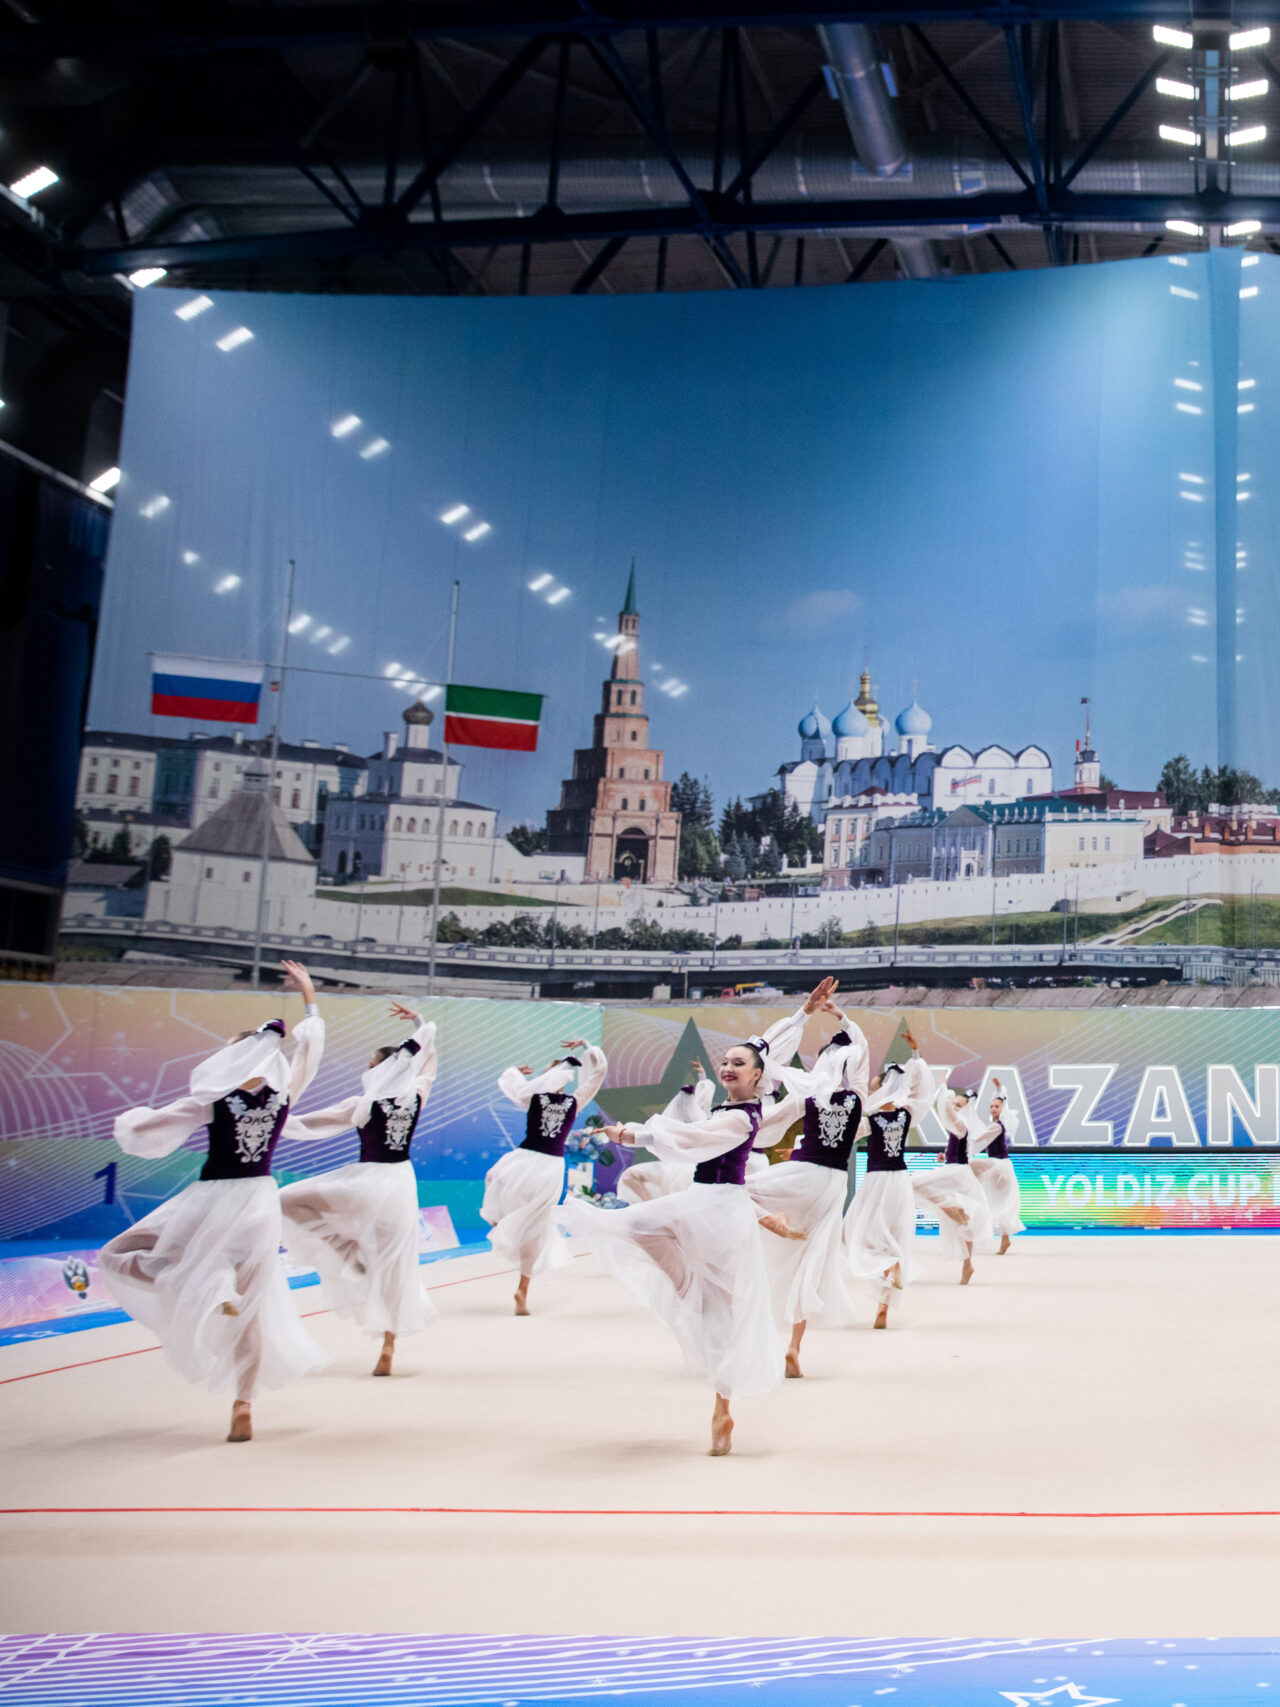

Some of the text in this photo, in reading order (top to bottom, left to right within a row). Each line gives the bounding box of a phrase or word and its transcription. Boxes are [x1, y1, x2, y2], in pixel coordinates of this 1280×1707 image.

[94, 1161, 118, 1205] 1
[1039, 1174, 1177, 1207] YOLDIZ
[1187, 1174, 1262, 1207] CUP
